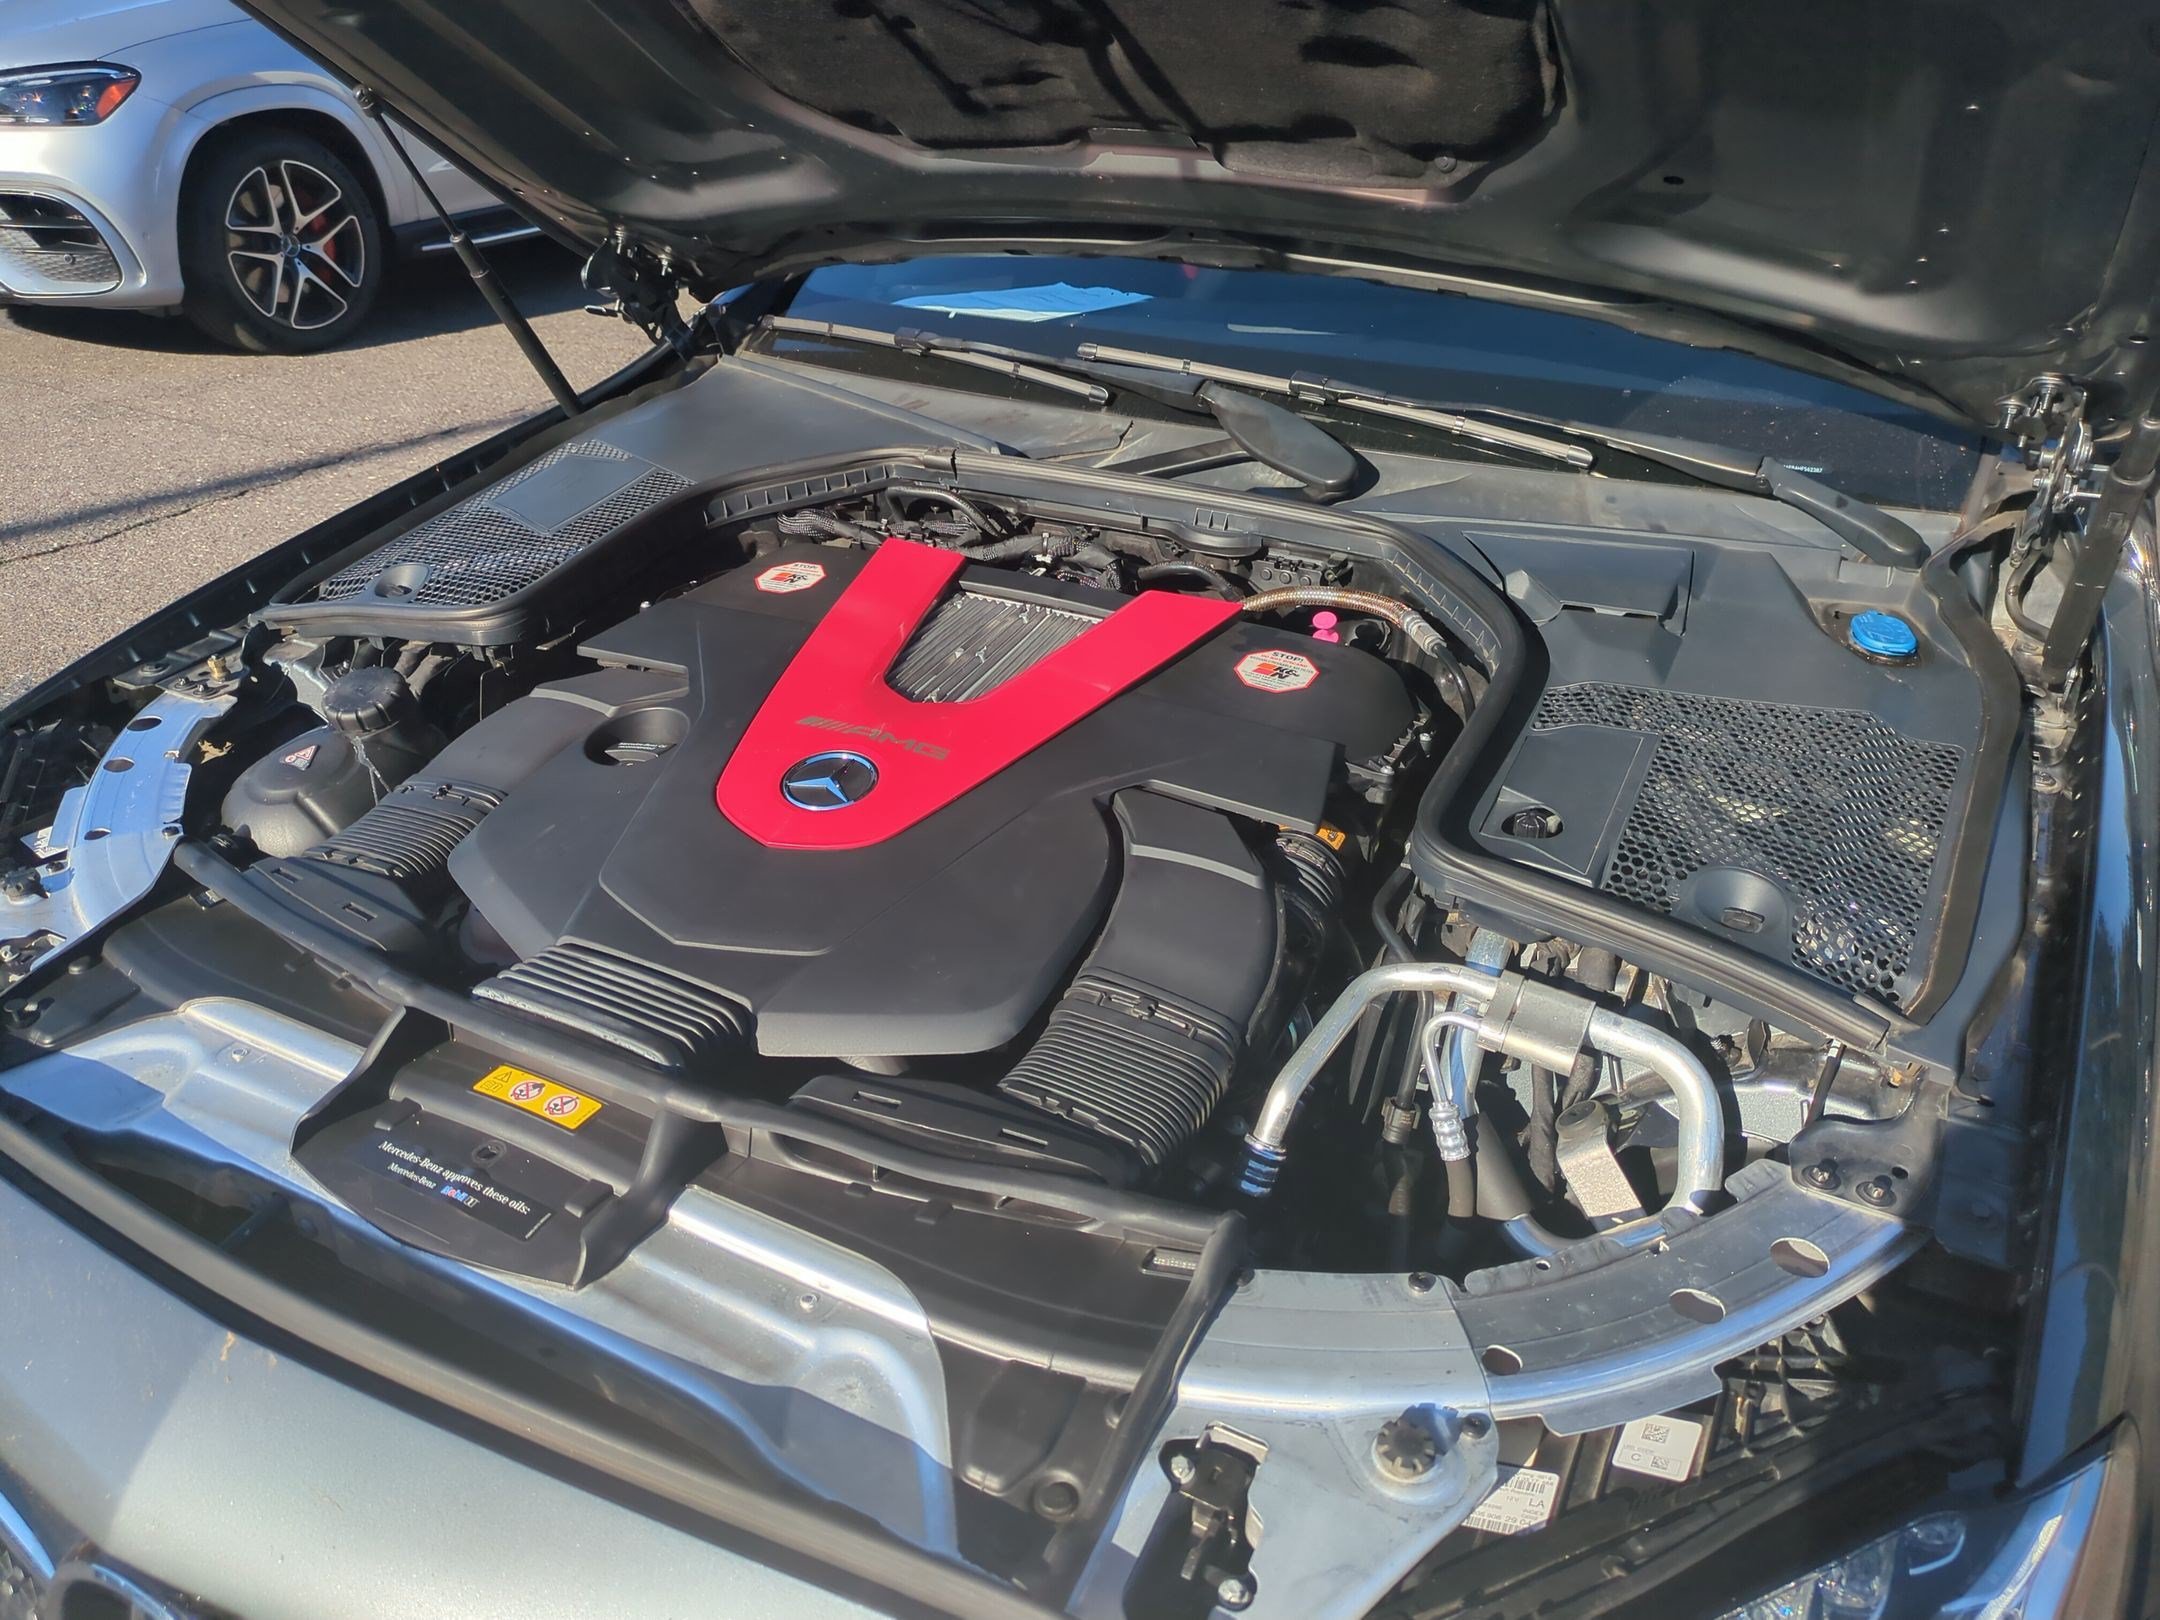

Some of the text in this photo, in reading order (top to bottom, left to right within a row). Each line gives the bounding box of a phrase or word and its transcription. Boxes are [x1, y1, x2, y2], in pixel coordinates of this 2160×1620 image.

[378, 1141, 531, 1215] Mercedes-Benz approves these oils:
[387, 1162, 437, 1190] Mercedes-Benz
[440, 1185, 468, 1203] Mobil
